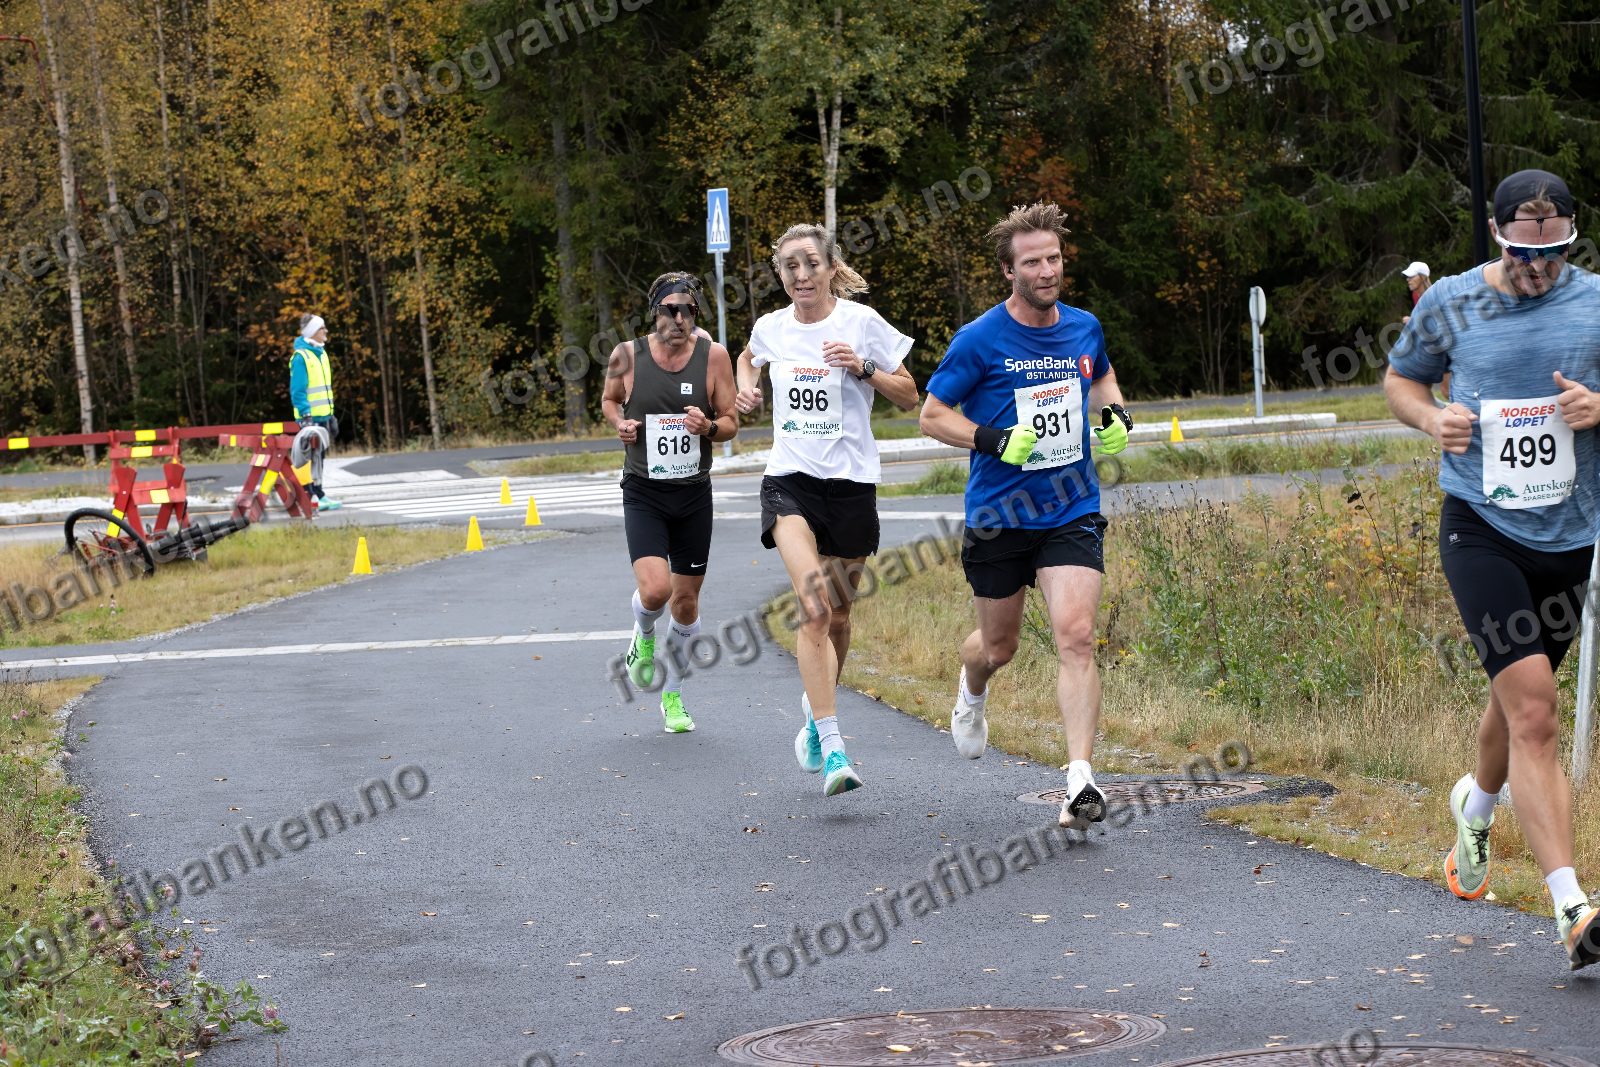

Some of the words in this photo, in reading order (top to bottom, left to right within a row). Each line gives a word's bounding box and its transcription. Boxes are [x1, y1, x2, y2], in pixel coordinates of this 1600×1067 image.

[792, 367, 830, 377] NORGES
[1004, 356, 1078, 373] SpareBank
[1083, 358, 1091, 375] 1
[794, 374, 824, 383] LØPET
[1026, 371, 1079, 380] ØSTLANDET
[788, 387, 829, 412] 996
[1032, 385, 1070, 401] NORGES
[1036, 394, 1065, 408] LØPET
[1500, 404, 1556, 418] NORGES
[802, 421, 840, 432] Aurskog
[1032, 408, 1071, 440] 931
[1505, 415, 1548, 429] LØPET
[657, 434, 691, 456] 618
[1500, 433, 1556, 469] 499
[1522, 479, 1573, 495] Aurskog
